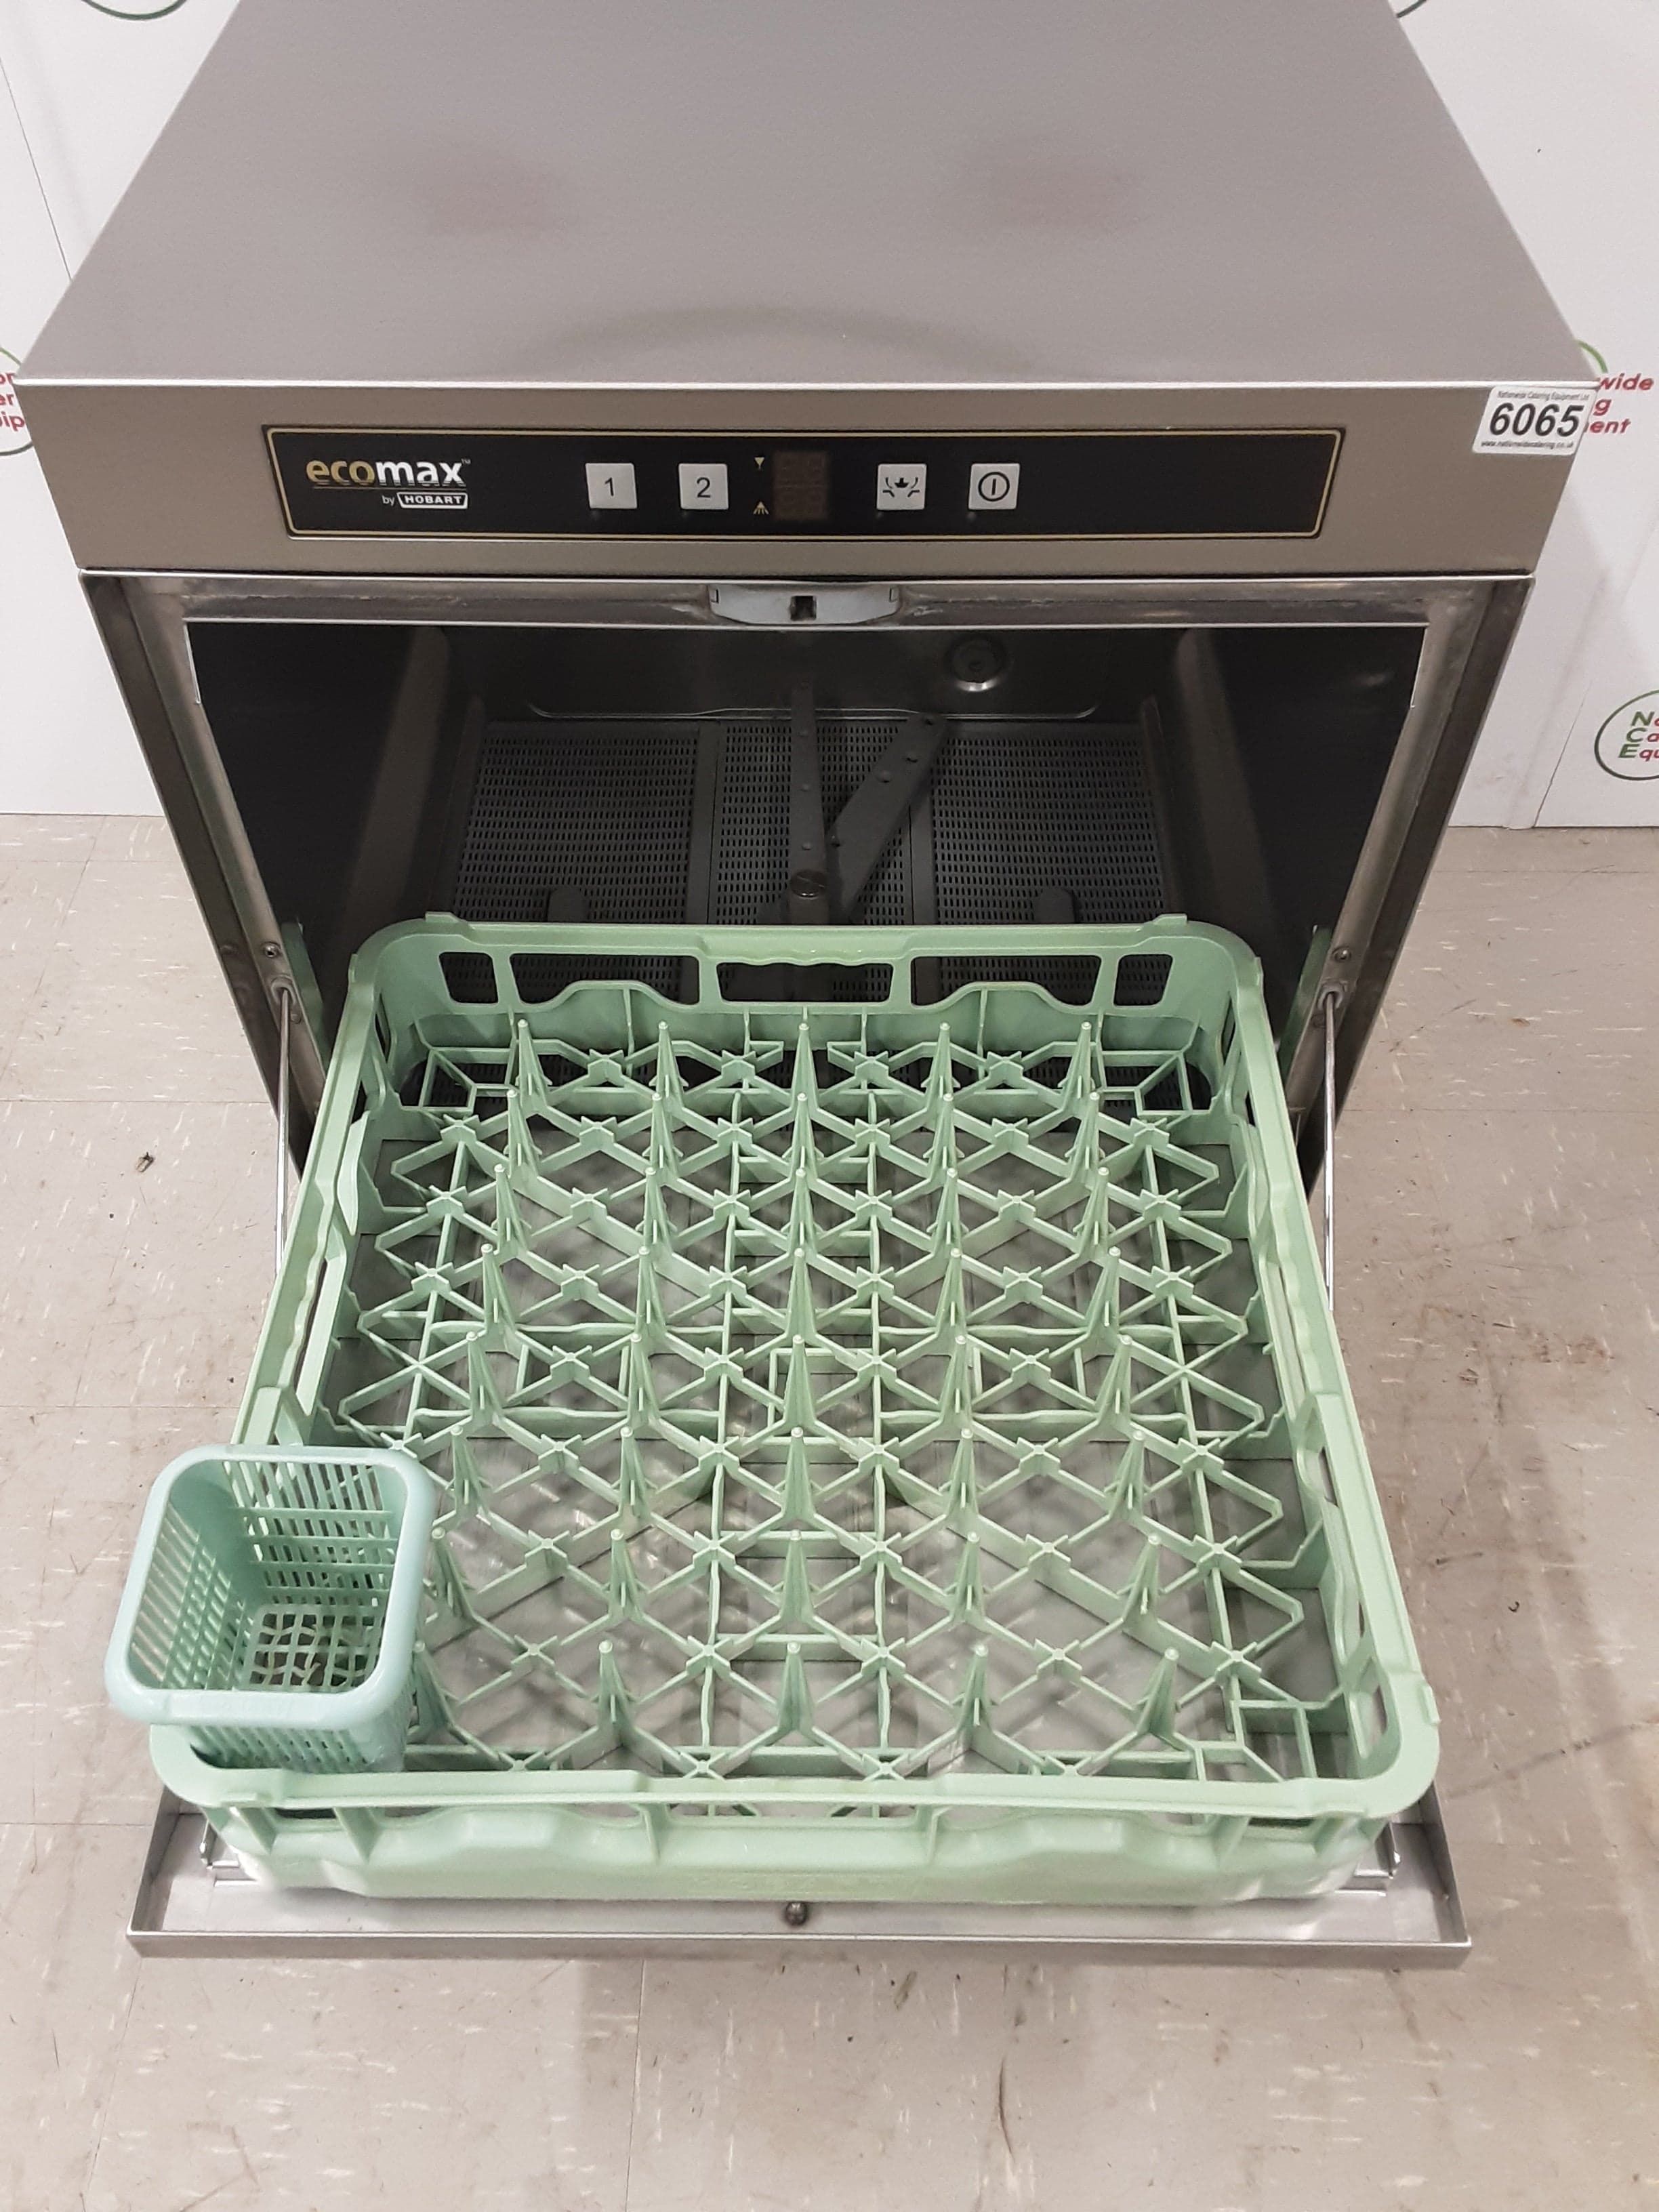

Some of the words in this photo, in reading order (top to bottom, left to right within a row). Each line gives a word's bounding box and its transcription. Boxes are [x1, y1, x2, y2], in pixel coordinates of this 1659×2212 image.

[0, 411, 25, 431] ip
[1490, 403, 1584, 436] 6065
[1584, 419, 1631, 433] ent
[306, 460, 466, 487] ecomax
[605, 477, 614, 497] 1
[696, 477, 711, 498] 2
[382, 495, 394, 506] by
[404, 495, 462, 504] HOBART
